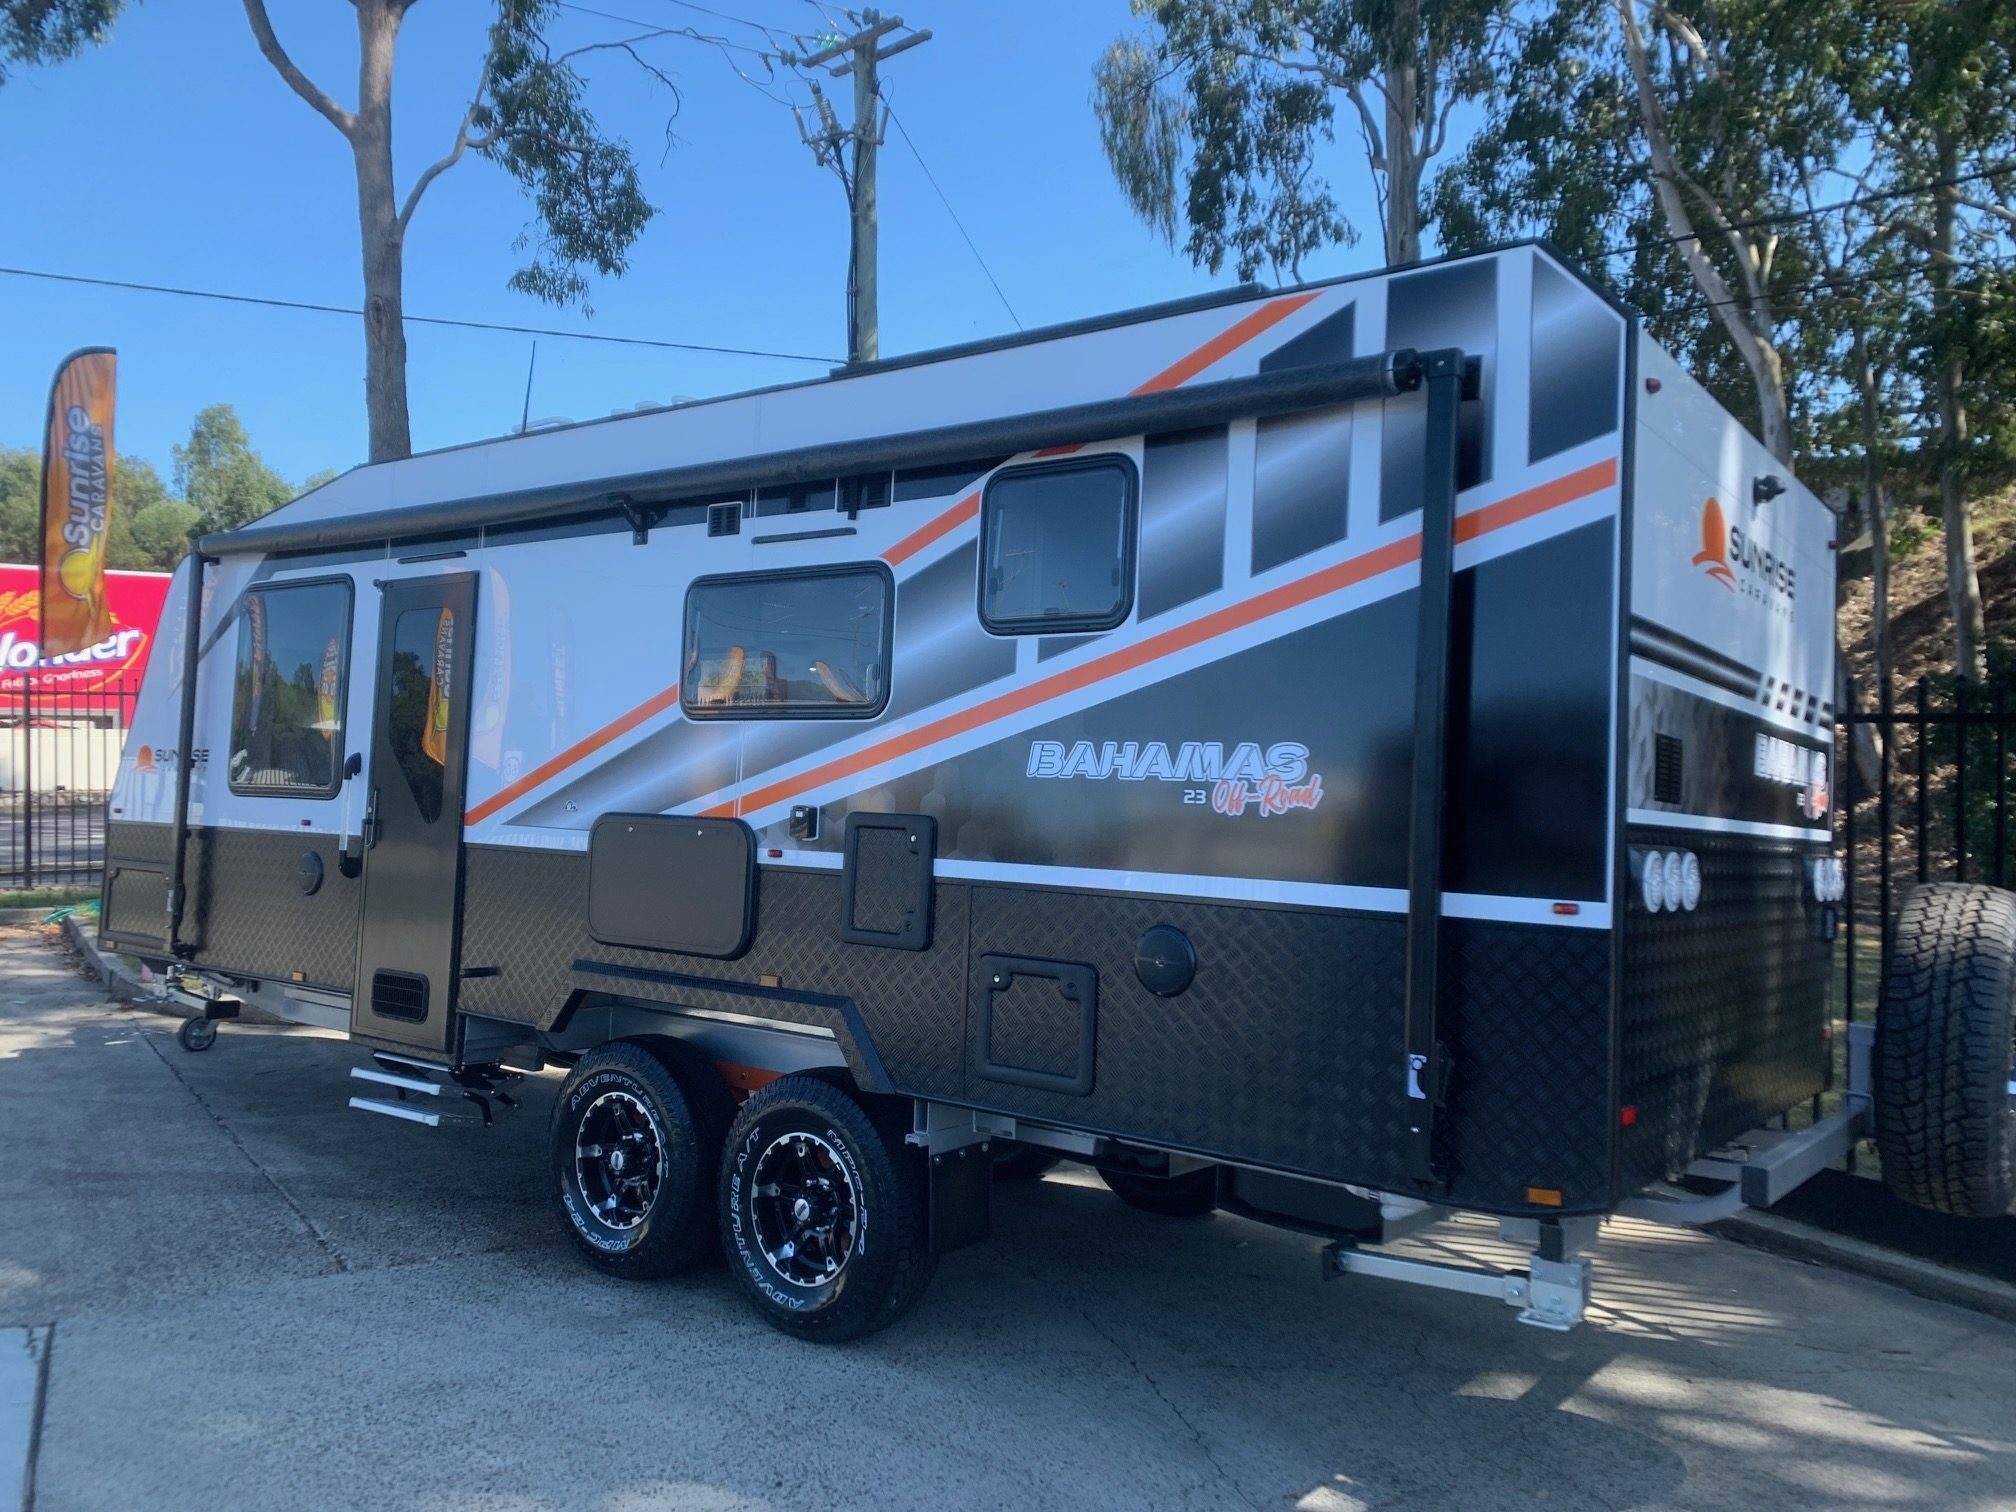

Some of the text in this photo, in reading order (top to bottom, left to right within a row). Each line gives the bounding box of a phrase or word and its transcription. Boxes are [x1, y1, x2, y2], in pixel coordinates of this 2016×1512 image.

[62, 405, 91, 546] Sunrise
[90, 424, 106, 532] CARAVANS
[1729, 525, 1796, 600] SUNRISE
[155, 747, 209, 762] SUNSE
[1026, 741, 1310, 784] BAHAMAS
[1184, 774, 1324, 818] 23 Off-Road
